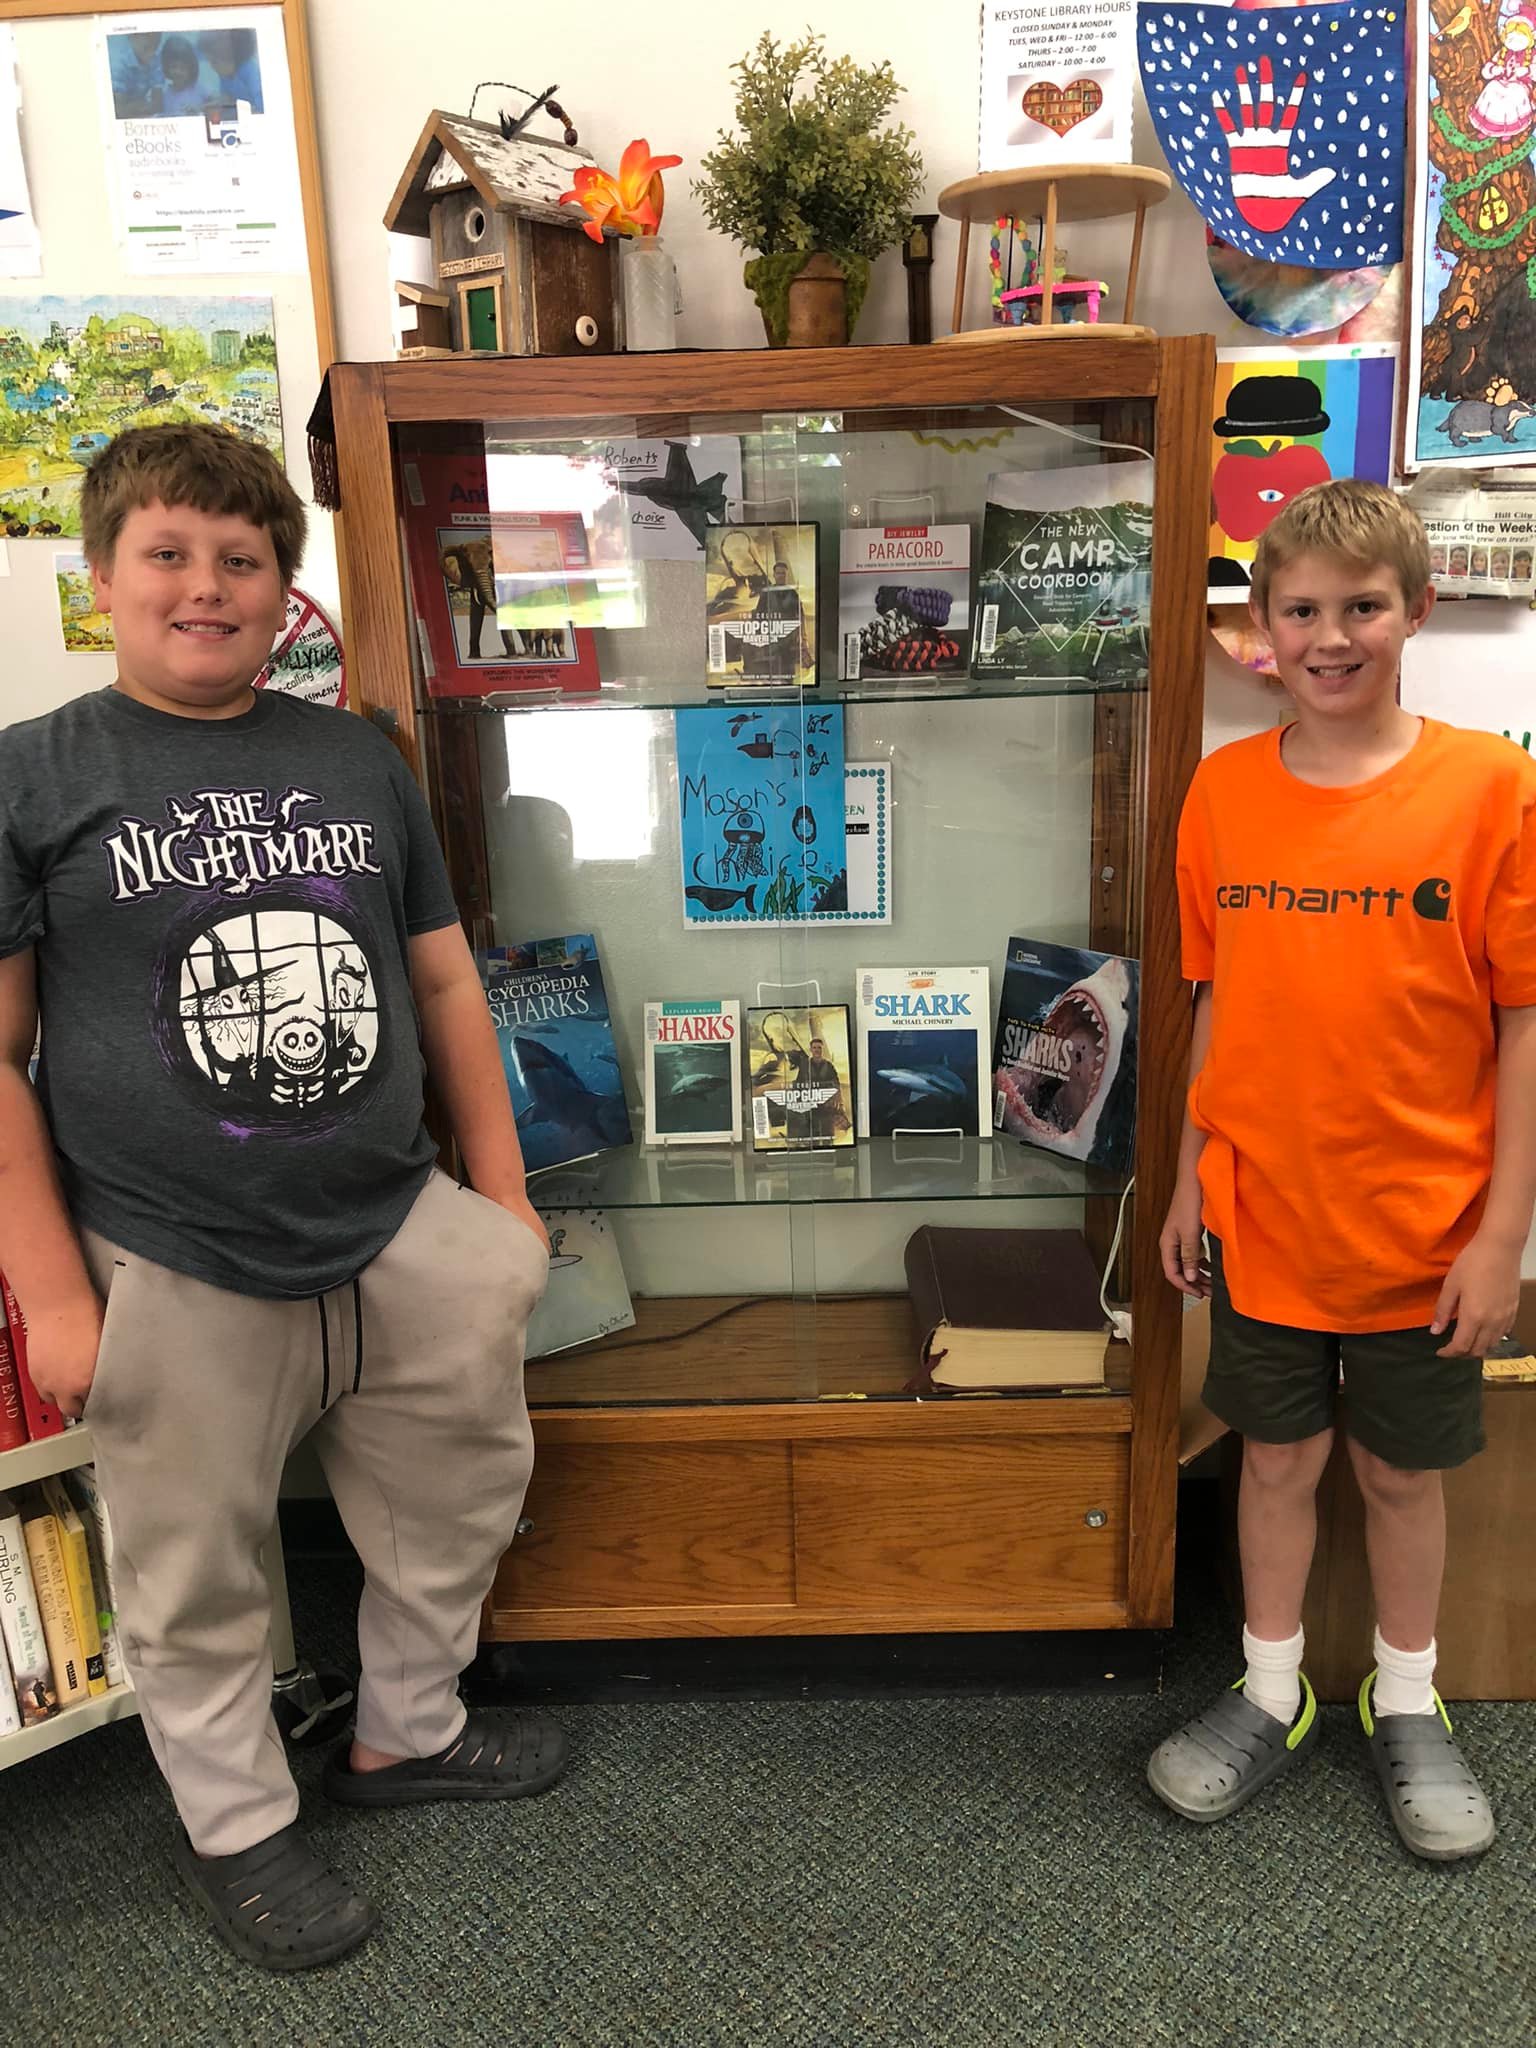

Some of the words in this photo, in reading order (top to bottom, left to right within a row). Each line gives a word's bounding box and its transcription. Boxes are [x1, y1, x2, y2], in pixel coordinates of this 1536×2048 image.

[995, 7, 1047, 22] KEYSTONE
[1049, 4, 1092, 17] LIBRARY
[1094, 1, 1132, 14] HOURS
[1012, 24, 1040, 34] CLOSED
[1041, 21, 1071, 32] SUNDAY
[1071, 21, 1077, 30] &
[1079, 20, 1112, 29] MONDAY
[1029, 36, 1047, 45] WED
[1047, 35, 1054, 43] &
[1055, 34, 1067, 43] FRI
[1028, 48, 1051, 57] THURS
[1018, 60, 1056, 69] SATURDAY
[124, 121, 177, 137] Borrow
[125, 137, 182, 155] eBooks
[1040, 526, 1064, 538] THE
[1068, 524, 1098, 537] NEW
[1424, 522, 1460, 532] estion
[1464, 522, 1473, 532] of
[1476, 523, 1495, 533] the
[1499, 523, 1536, 533] Week:
[868, 540, 944, 560] PARACORD
[1020, 539, 1116, 571] CAMP
[1017, 571, 1113, 590] COOKBOOK
[277, 670, 316, 692] -calling
[304, 680, 340, 702] ssment
[683, 773, 788, 820] Mason's
[195, 791, 275, 829] THE
[105, 818, 383, 900] NIGHTMARE
[1216, 880, 1404, 917] carhartt
[489, 989, 590, 1029] SHARKS
[875, 994, 972, 1017] SHARK
[1002, 1024, 1073, 1073] SHARKS
[0, 1340, 12, 1377] THE
[1, 1383, 19, 1420] END
[10, 1553, 19, 1562] S
[0, 1536, 17, 1604] STIRLING
[14, 1566, 22, 1577] M
